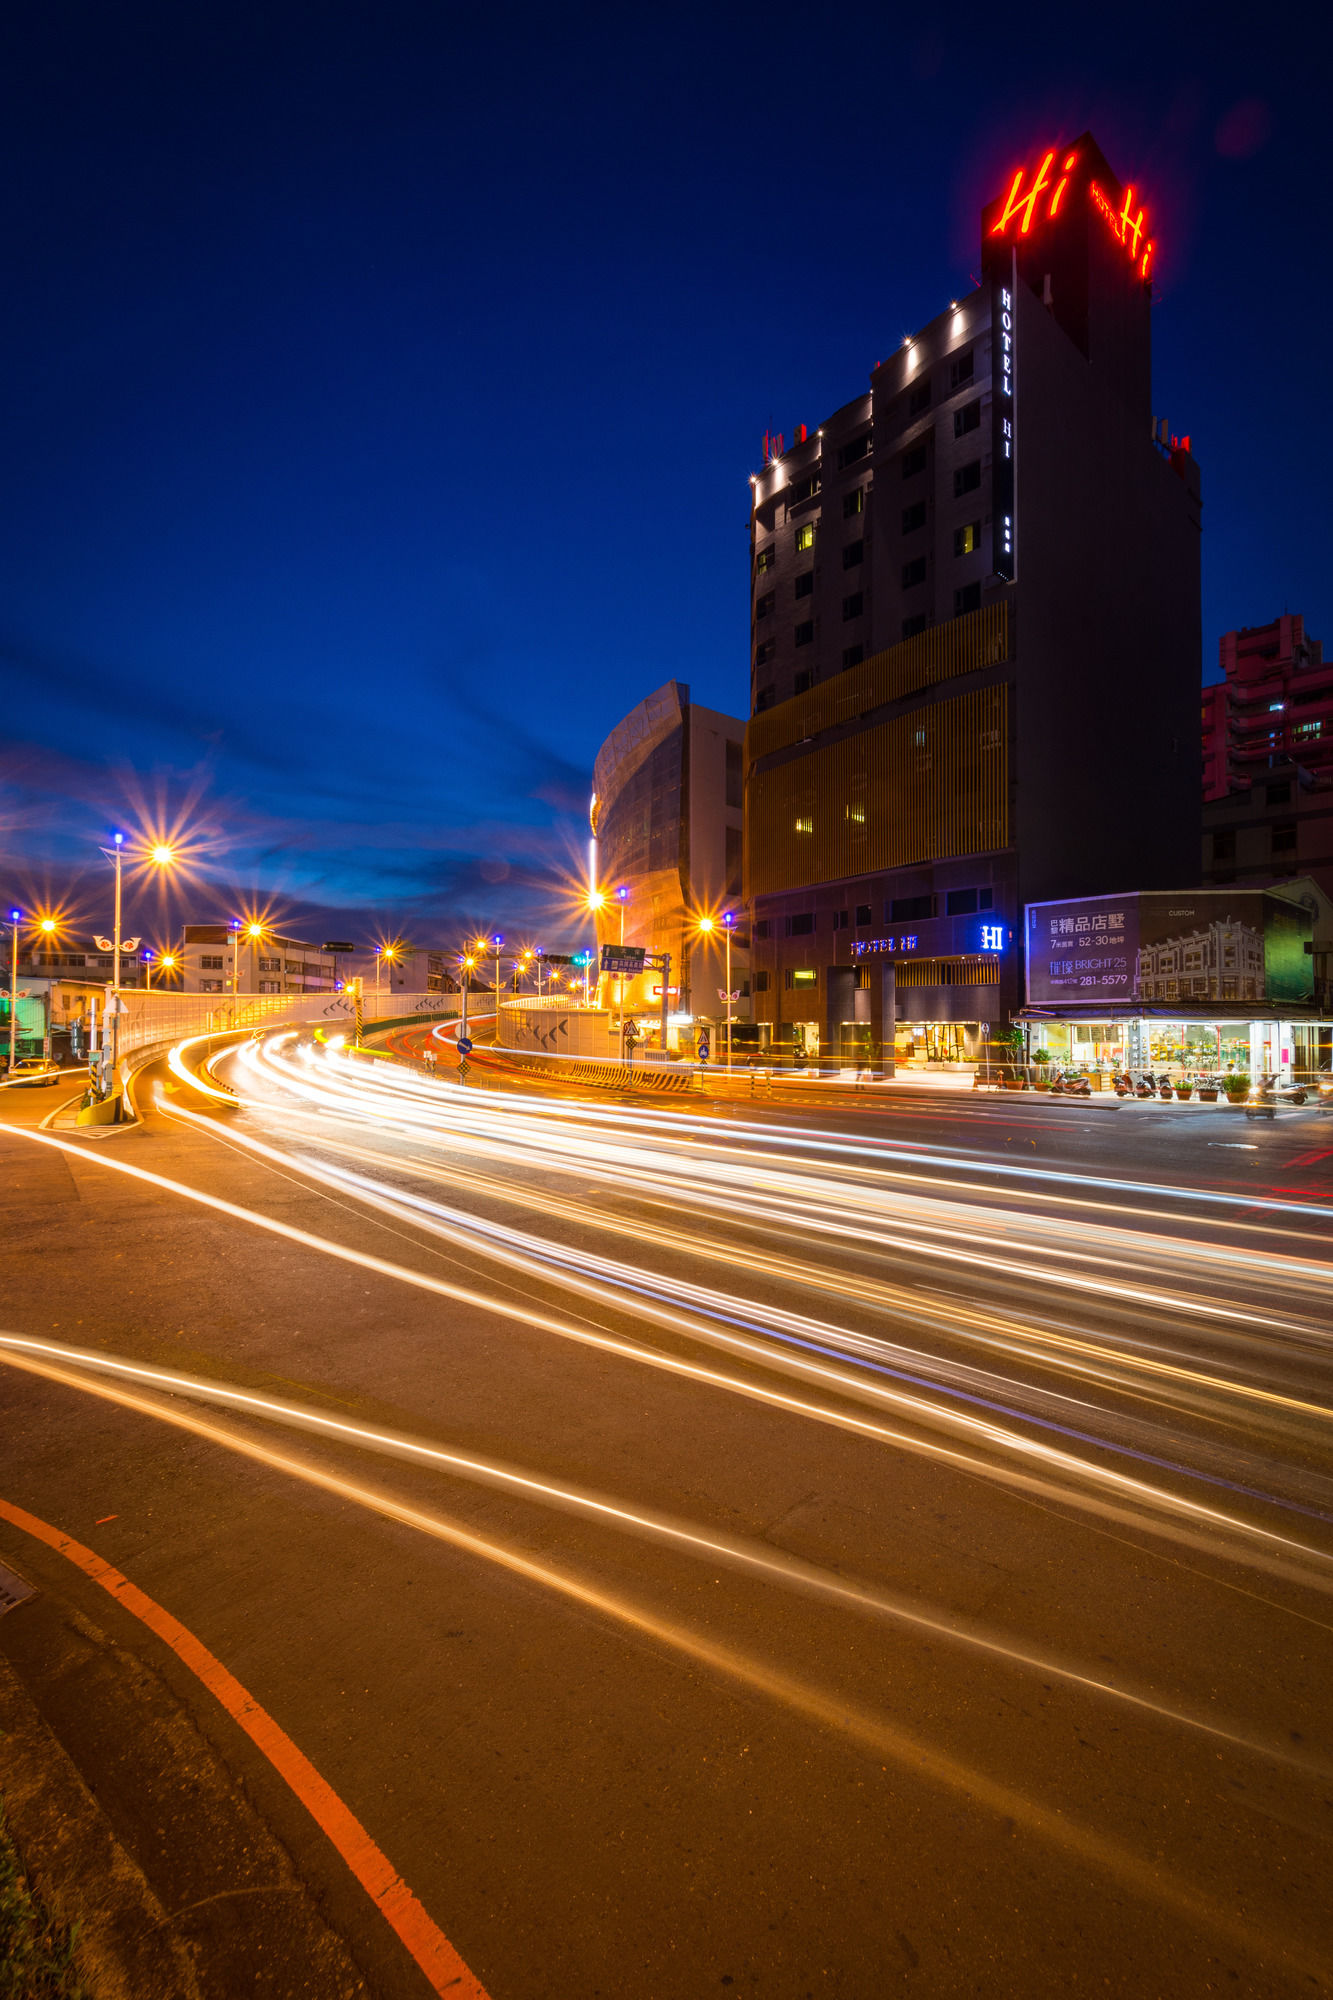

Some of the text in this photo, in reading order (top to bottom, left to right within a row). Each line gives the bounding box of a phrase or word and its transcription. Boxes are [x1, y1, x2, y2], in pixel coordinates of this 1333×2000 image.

[990, 149, 1077, 235] Hi
[1090, 182, 1121, 239] HOTEL
[1119, 186, 1152, 277] Hi
[1002, 288, 1012, 458] HOTEL HI
[850, 935, 918, 955] HOTEL HI
[983, 926, 1003, 950] HI
[1075, 958, 1112, 969] BRIGHT
[1113, 957, 1127, 968] 25
[1080, 975, 1128, 985] 281-5579
